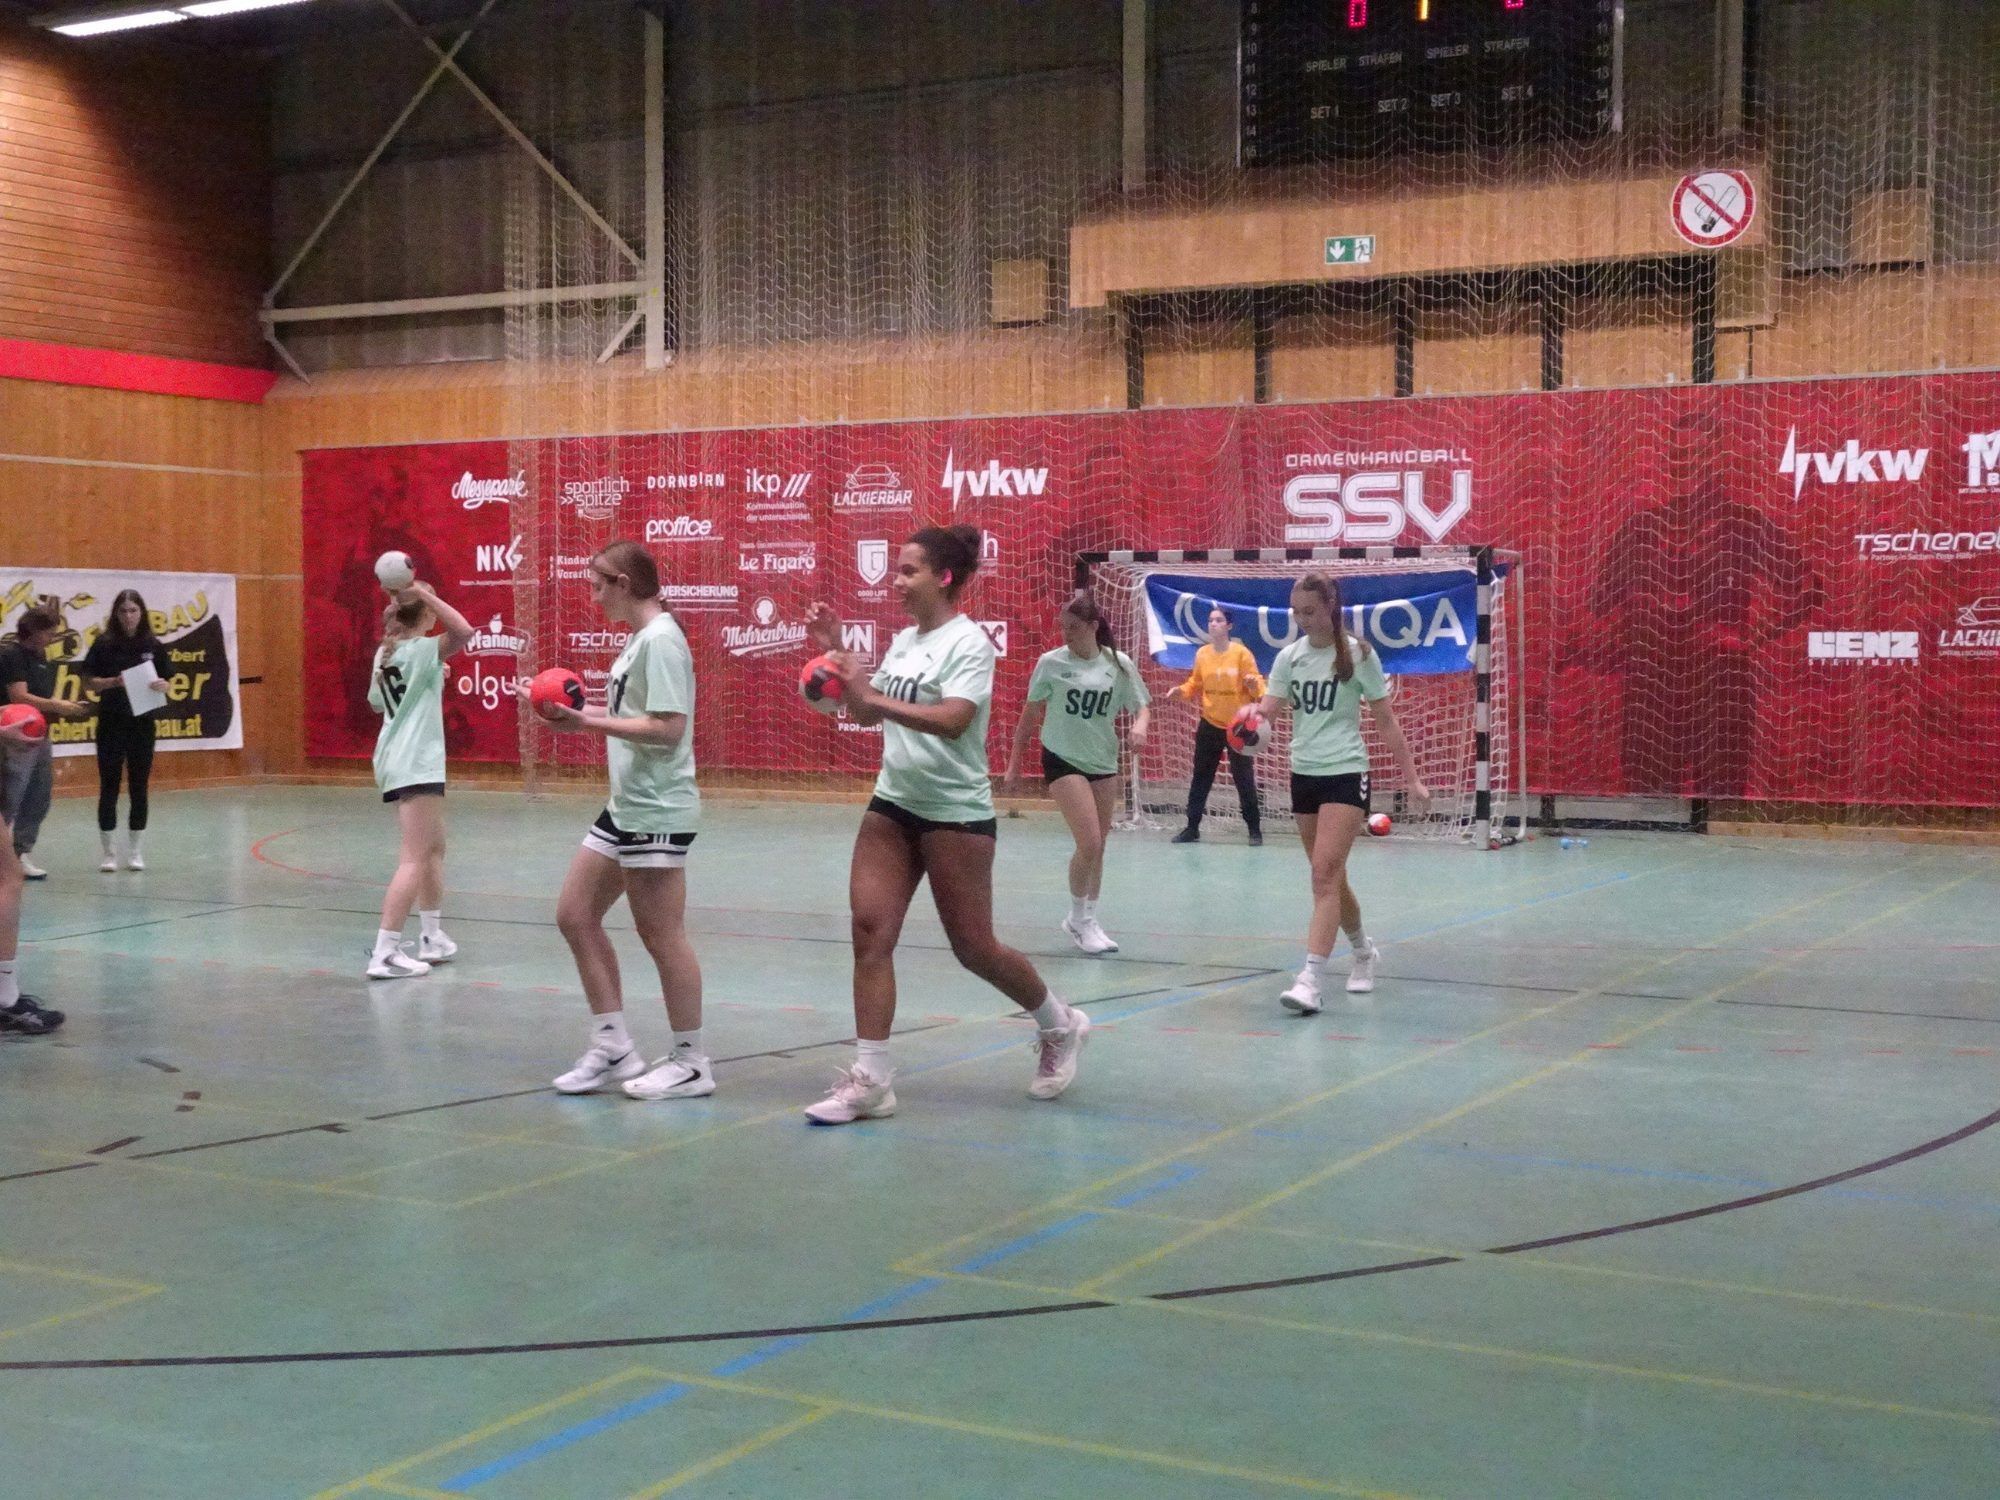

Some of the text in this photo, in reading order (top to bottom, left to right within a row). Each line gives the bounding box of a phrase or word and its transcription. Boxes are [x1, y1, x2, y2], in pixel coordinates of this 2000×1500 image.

[1426, 37, 1530, 60] SPIELER STRAFEN
[1306, 51, 1403, 73] SPIELER STRAFEN
[1246, 84, 1257, 97] 12
[1430, 93, 1452, 107] SET
[1501, 86, 1524, 101] SET
[1246, 105, 1257, 117] 13
[1310, 106, 1331, 120] SET
[1377, 100, 1398, 114] SET
[1286, 448, 1473, 467] DAMENHANDBALL
[1813, 439, 1930, 483] vkw
[564, 476, 630, 496] sportlich
[647, 472, 725, 489] DORNBIRN
[746, 469, 781, 498] ikp
[965, 459, 1049, 497] vkw
[452, 470, 528, 509] Messepark
[576, 491, 622, 508] spitze
[834, 489, 913, 506] LACKIERBAR
[1284, 469, 1473, 544] SSV
[646, 516, 712, 542] proffice
[1854, 528, 2000, 552] Tschene
[476, 535, 523, 572] NKG
[557, 555, 594, 565] Kinder
[739, 553, 759, 571] Le
[662, 584, 739, 598] VERSICHERUNG
[721, 620, 808, 648] Mohrenbräu
[1257, 597, 1468, 650] UIQA
[1808, 631, 1918, 658] LENZ
[1065, 686, 1114, 720] sgd
[1290, 675, 1340, 715] sgd
